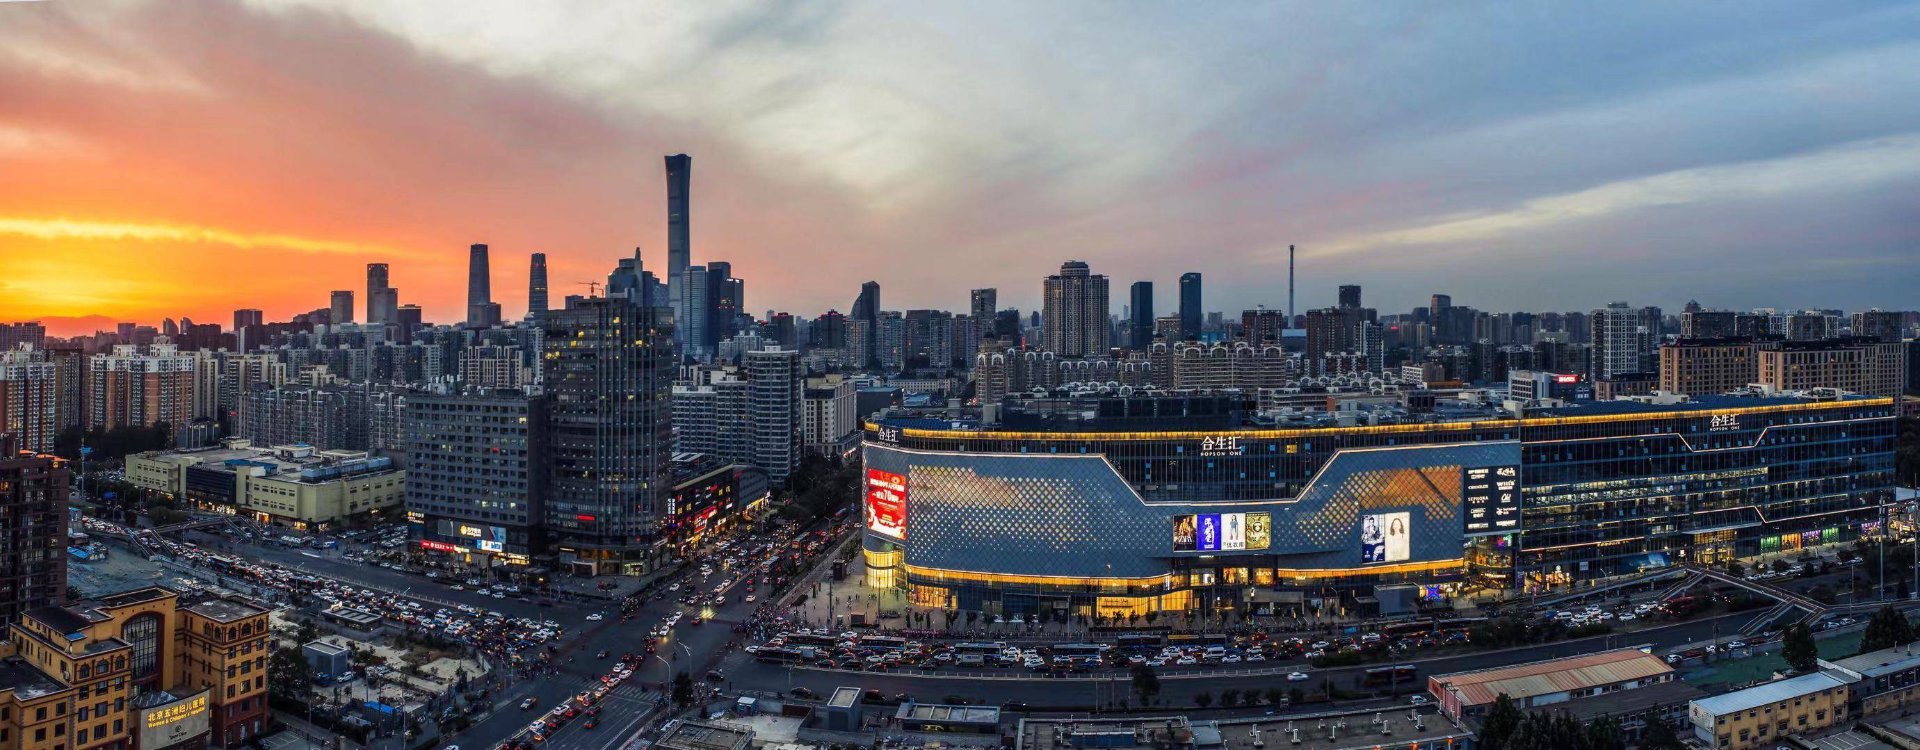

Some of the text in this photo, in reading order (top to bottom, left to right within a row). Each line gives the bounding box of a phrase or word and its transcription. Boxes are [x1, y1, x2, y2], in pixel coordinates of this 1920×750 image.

[1710, 414, 1740, 427] 合生汇
[878, 427, 899, 442] 合生汇
[1201, 436, 1242, 450] 合生汇
